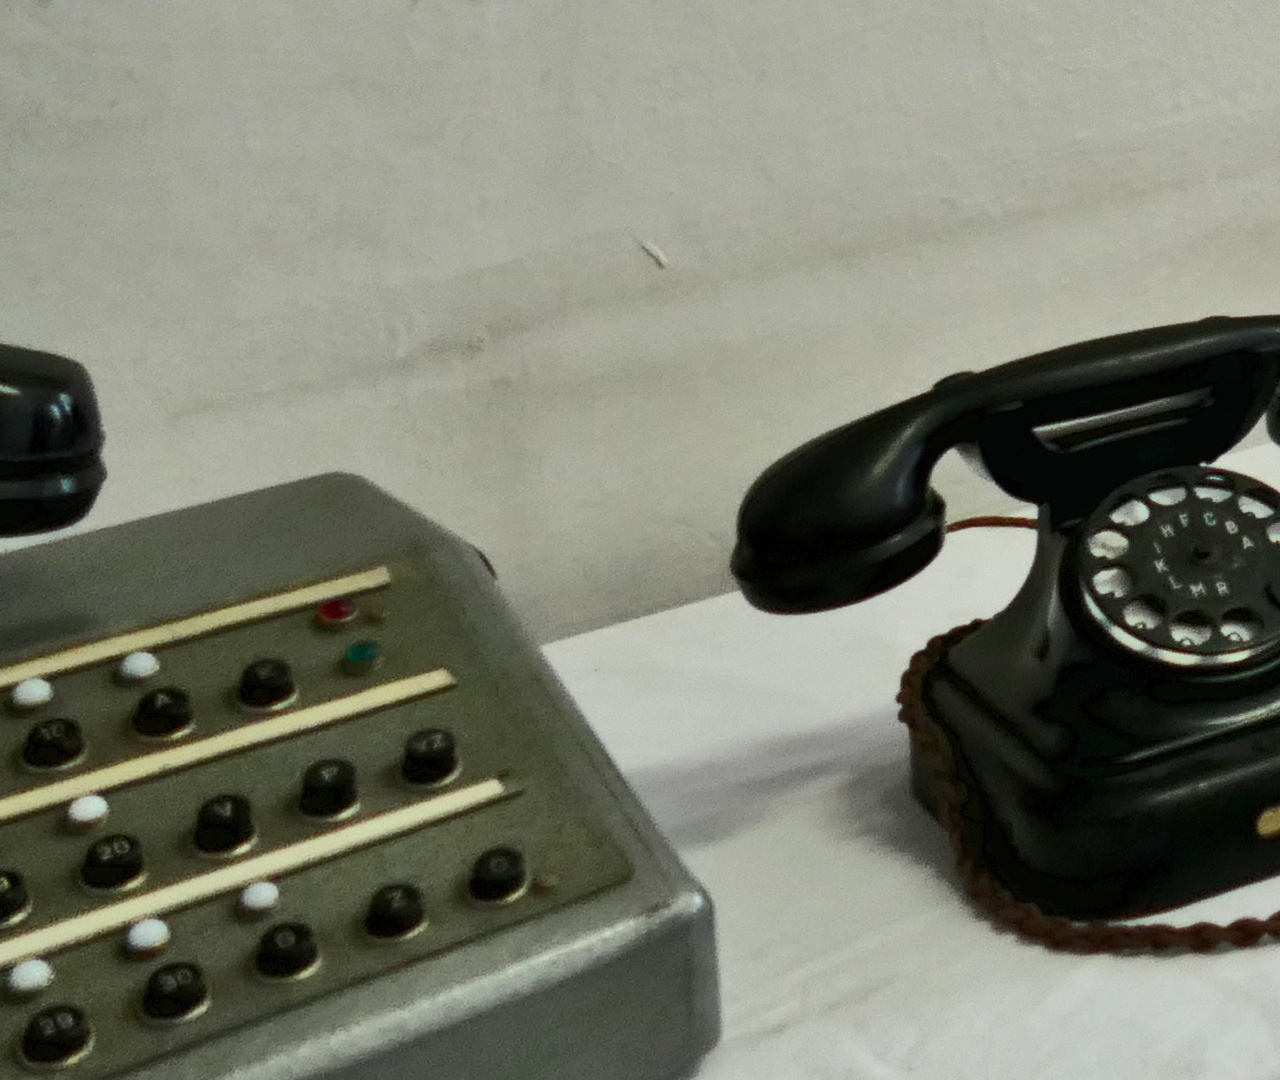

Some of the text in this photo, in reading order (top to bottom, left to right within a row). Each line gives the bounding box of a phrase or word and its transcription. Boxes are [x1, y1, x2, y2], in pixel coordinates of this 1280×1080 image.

[1202, 511, 1217, 526] C
[1159, 522, 1176, 539] H
[1241, 535, 1255, 550] A
[1153, 558, 1170, 574] K
[1167, 575, 1183, 590] L
[1188, 581, 1208, 598] M
[97, 836, 131, 862] 20
